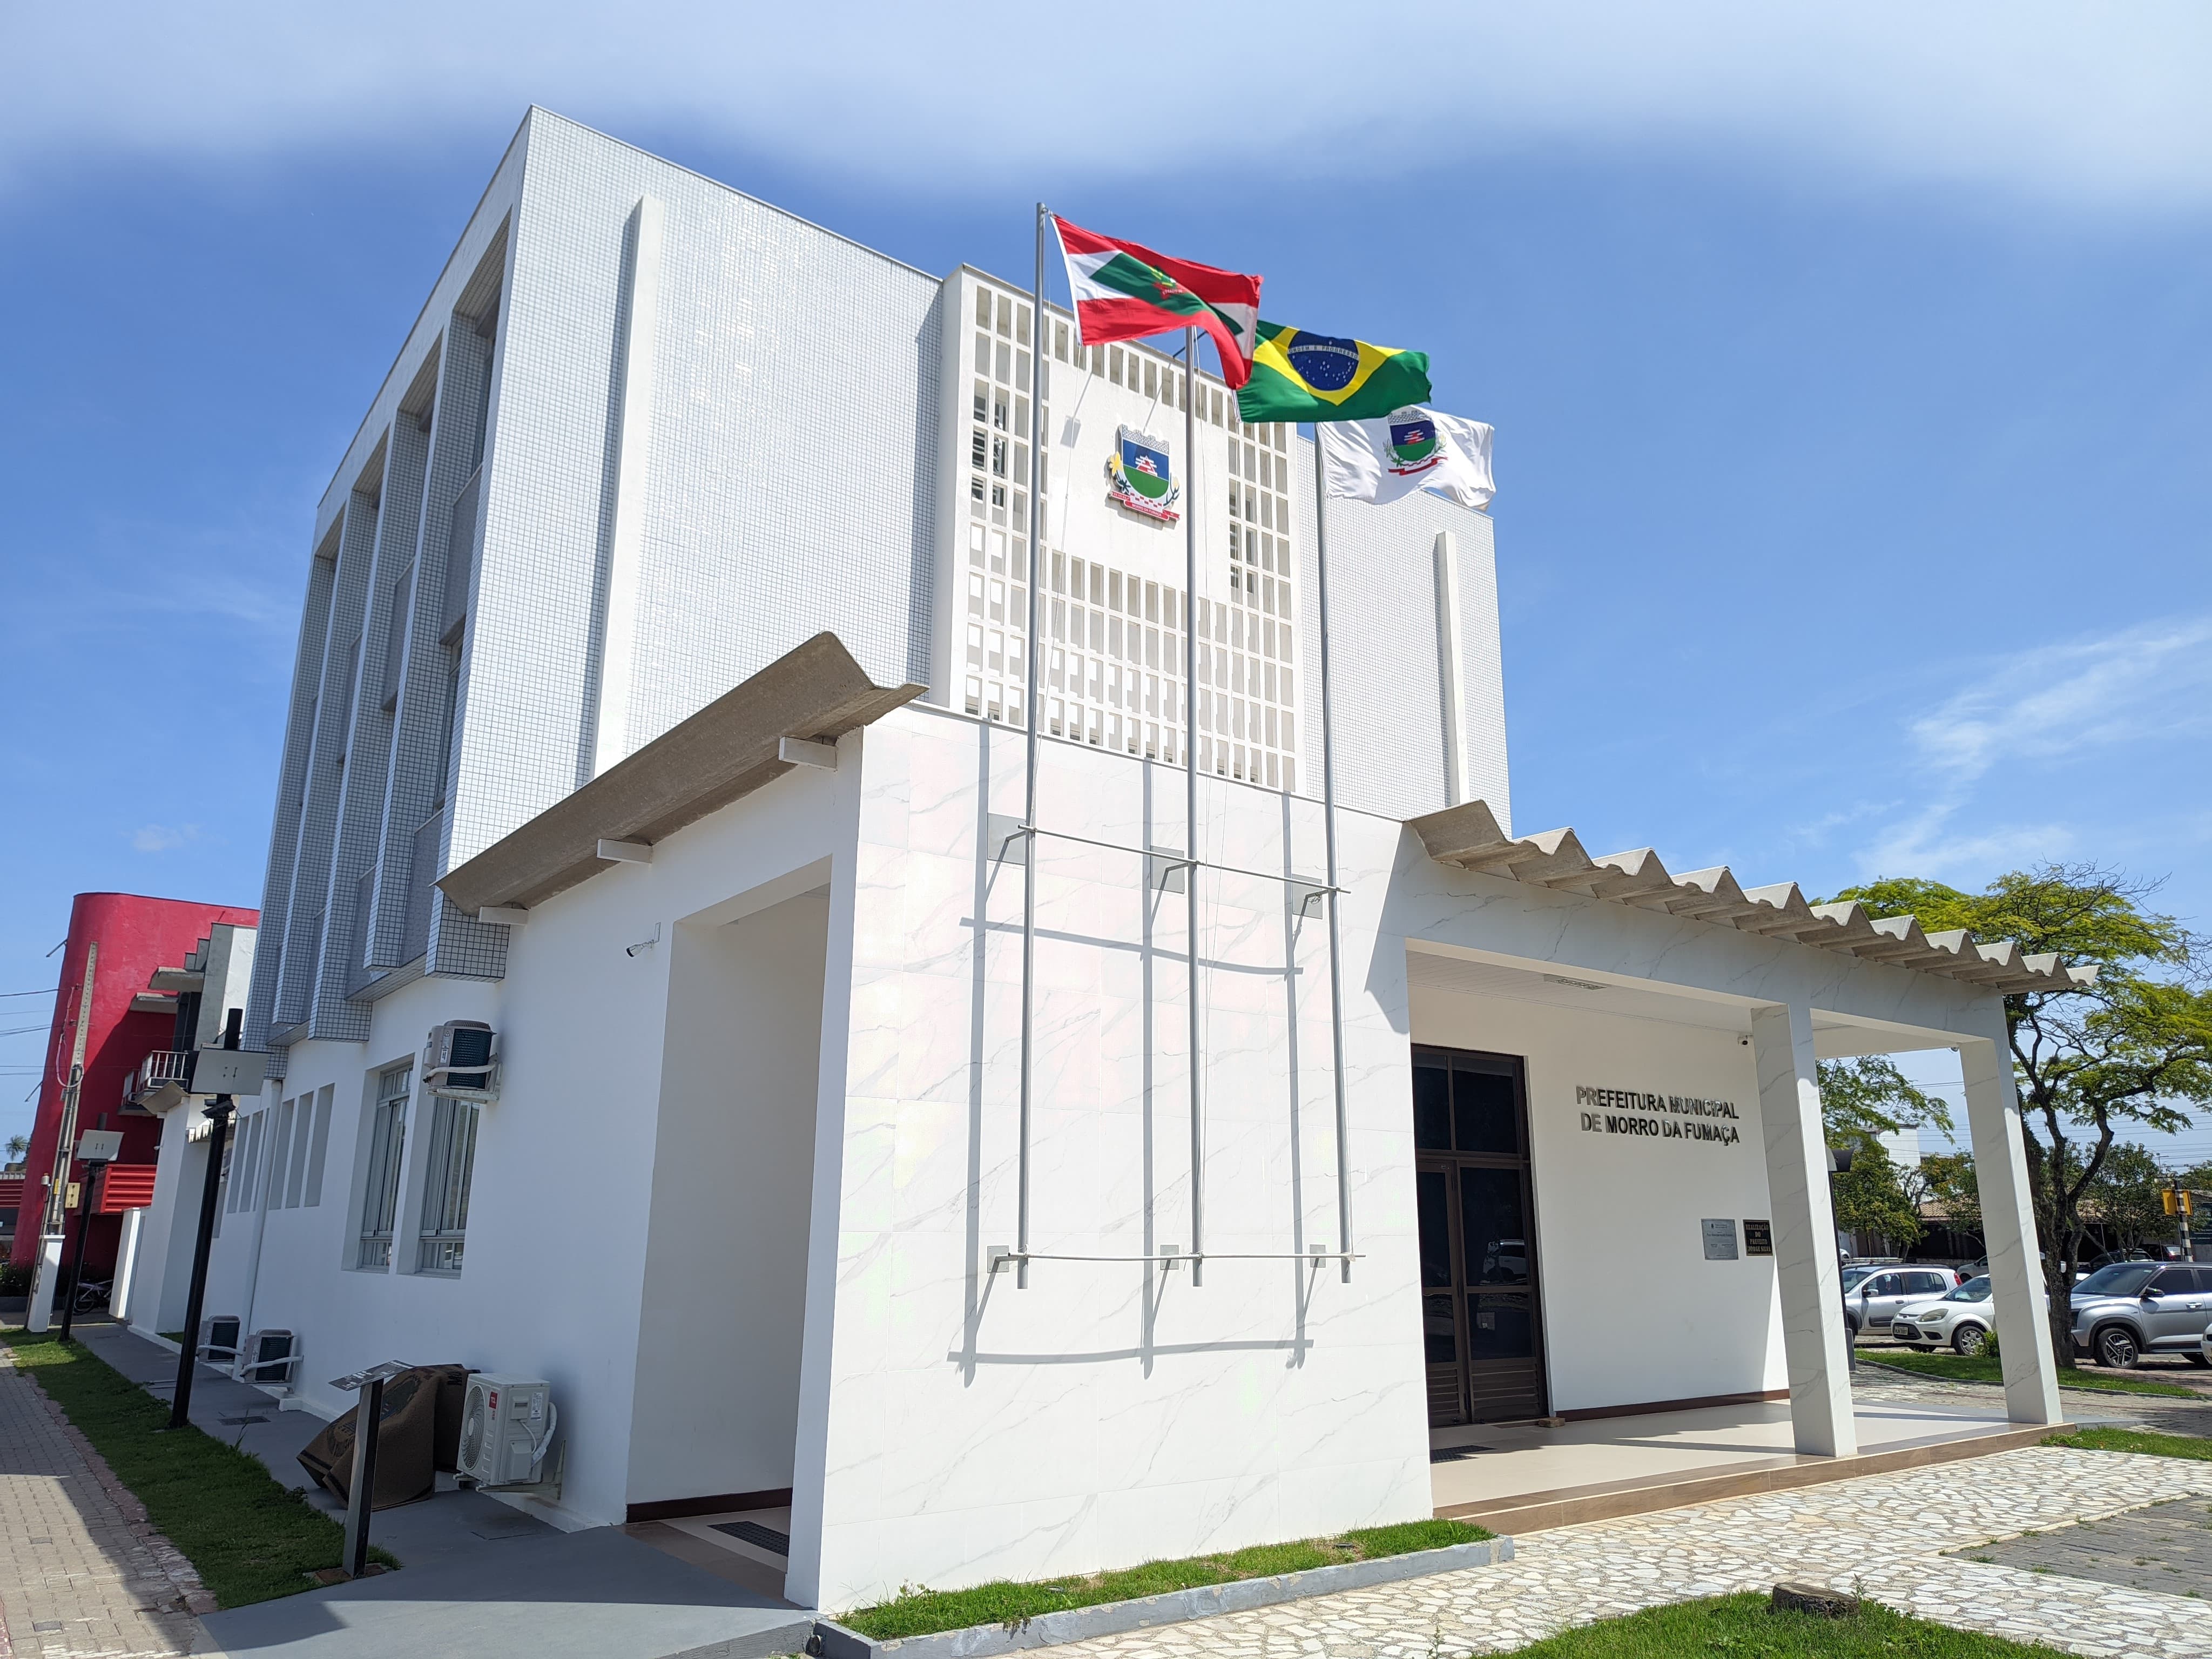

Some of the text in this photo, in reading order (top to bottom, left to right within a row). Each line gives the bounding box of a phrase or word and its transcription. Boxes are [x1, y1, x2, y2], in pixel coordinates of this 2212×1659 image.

[1289, 346, 1310, 354] ORDEM
[1321, 346, 1358, 359] PROGRESSO
[1576, 1086, 1739, 1120] PREFEITURA MUNICIPAL
[1580, 1112, 1740, 1147] DE MORRO DA FUMAÇA
